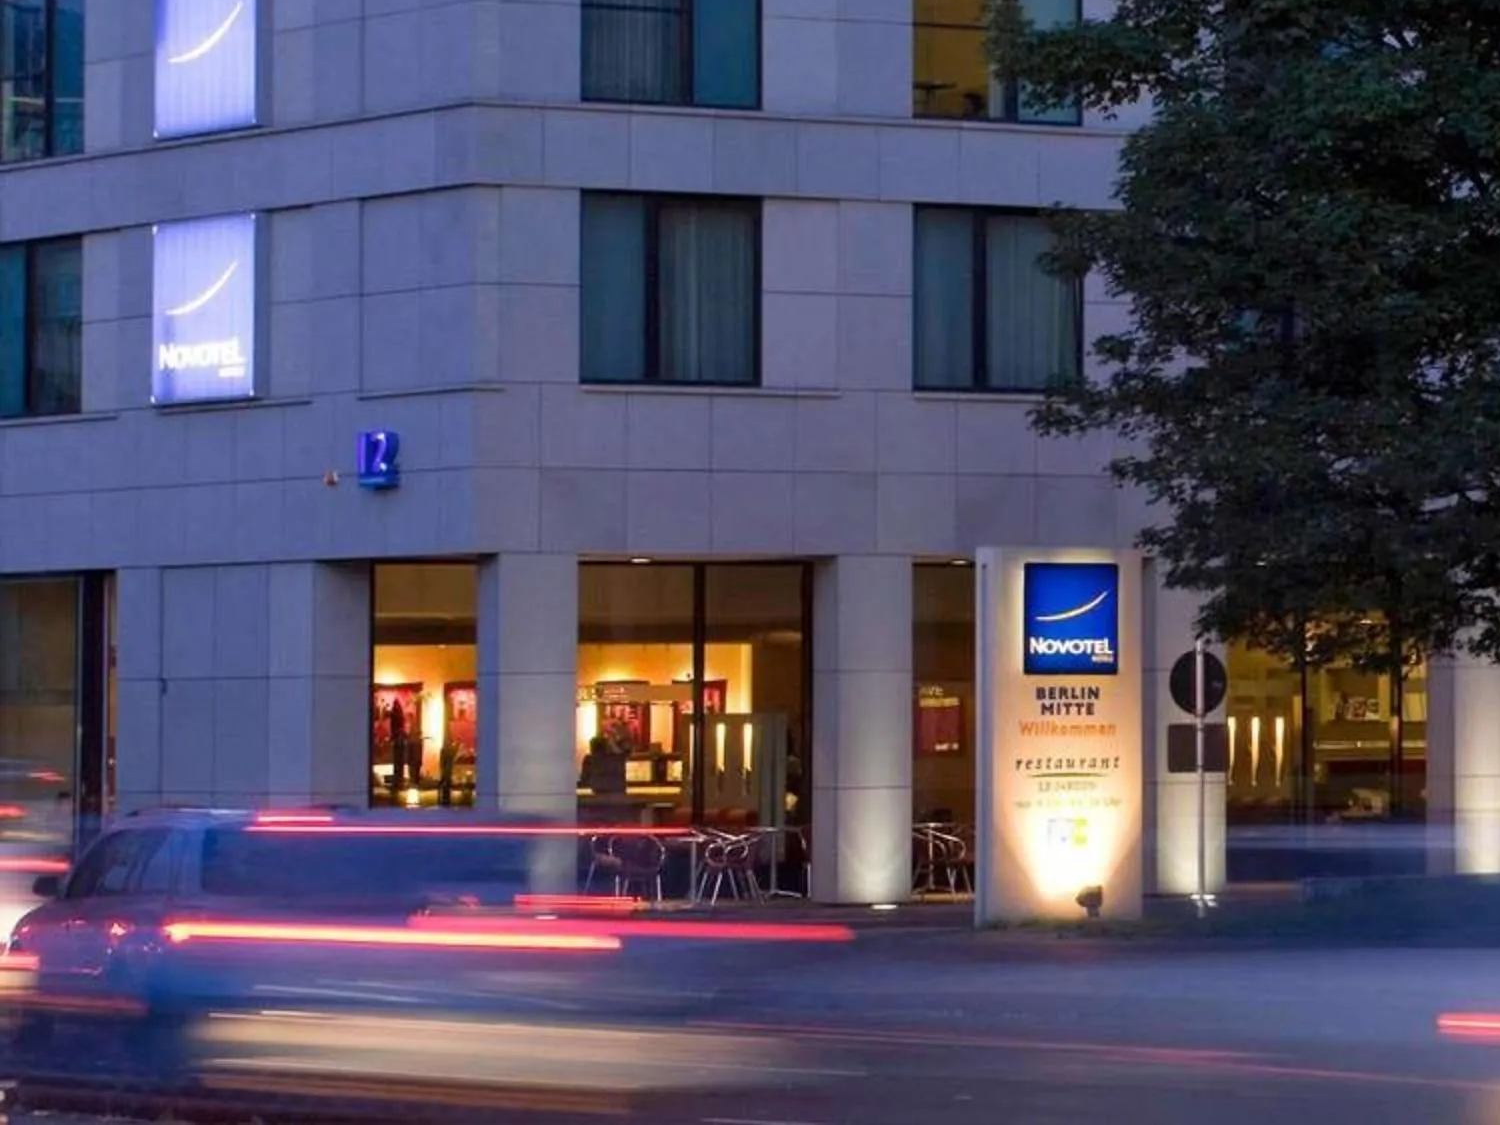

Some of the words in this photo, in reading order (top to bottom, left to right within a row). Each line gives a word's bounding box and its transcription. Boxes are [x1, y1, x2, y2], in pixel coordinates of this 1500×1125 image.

[159, 337, 246, 371] NOVOTEL
[1029, 637, 1114, 655] NOVOTEL
[1036, 686, 1100, 701] BERLIN
[1041, 702, 1095, 716] MITTE
[1015, 756, 1120, 770] restaurant
